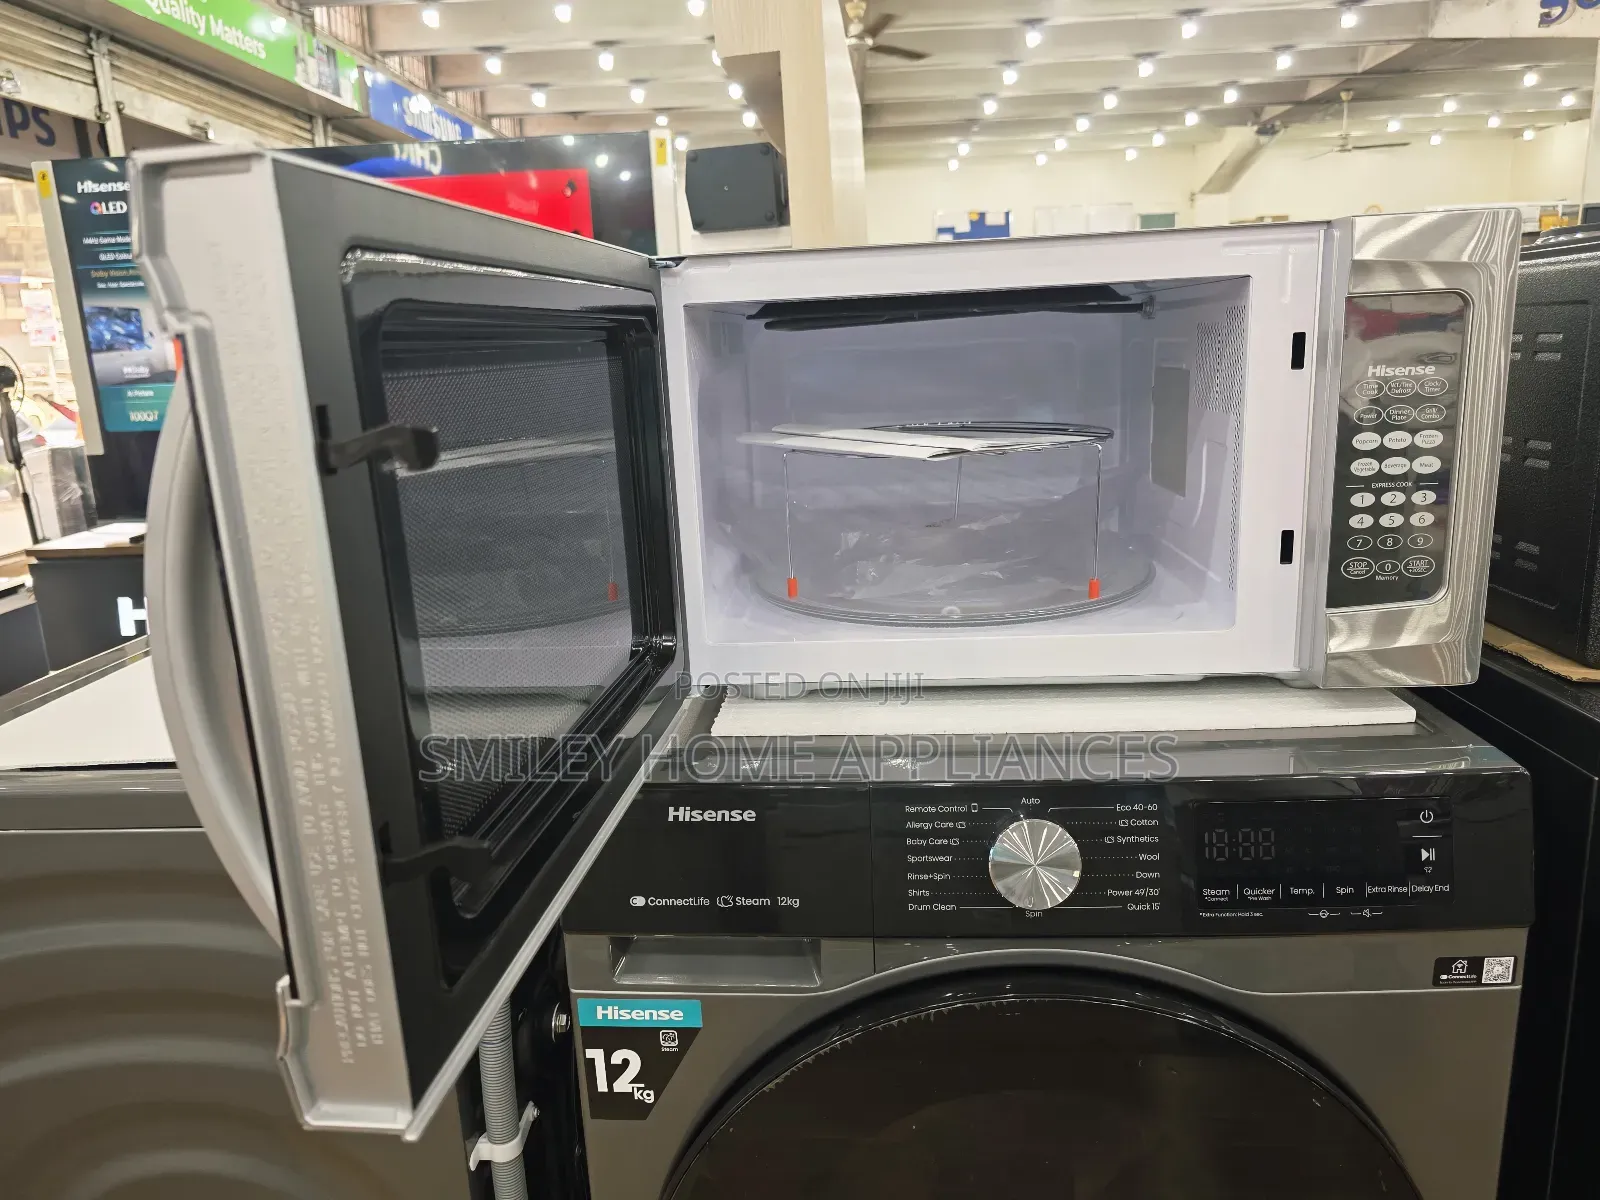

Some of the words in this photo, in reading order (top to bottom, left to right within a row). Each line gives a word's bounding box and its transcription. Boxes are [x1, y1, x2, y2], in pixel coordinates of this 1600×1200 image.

[209, 15, 267, 60] Matters
[0, 98, 56, 147] PS
[90, 201, 128, 215] QLED
[1368, 365, 1435, 377] Hisense
[1360, 495, 1364, 504] 1
[1390, 494, 1396, 503] 2
[1421, 493, 1426, 502] 3
[1357, 517, 1363, 526] 4
[1389, 516, 1394, 525] 5
[1419, 515, 1425, 524] 6
[1356, 539, 1362, 547] 7
[1387, 538, 1393, 546] 8
[1417, 537, 1423, 545] 9
[668, 806, 756, 822] Hisense
[906, 821, 933, 830] Allergy
[1131, 818, 1159, 826] Cotton
[907, 838, 926, 847] Baby
[1117, 835, 1159, 843] Synthetics
[907, 855, 952, 864] Sportswear
[907, 873, 950, 881] Rinse+Spin
[1244, 887, 1275, 896] Quicker
[1290, 887, 1315, 896] Temp.
[1336, 886, 1354, 894] Spin
[1388, 885, 1407, 893] Rinse
[1412, 884, 1433, 893] Delay
[648, 896, 710, 906] ConnectLife
[735, 896, 770, 906] Steam
[777, 896, 800, 908] 12kg
[1127, 903, 1150, 912] Quick
[1025, 910, 1042, 919] Spin
[596, 1006, 683, 1020] Hisense
[585, 1049, 644, 1092] 12
[633, 1086, 655, 1103] kg
